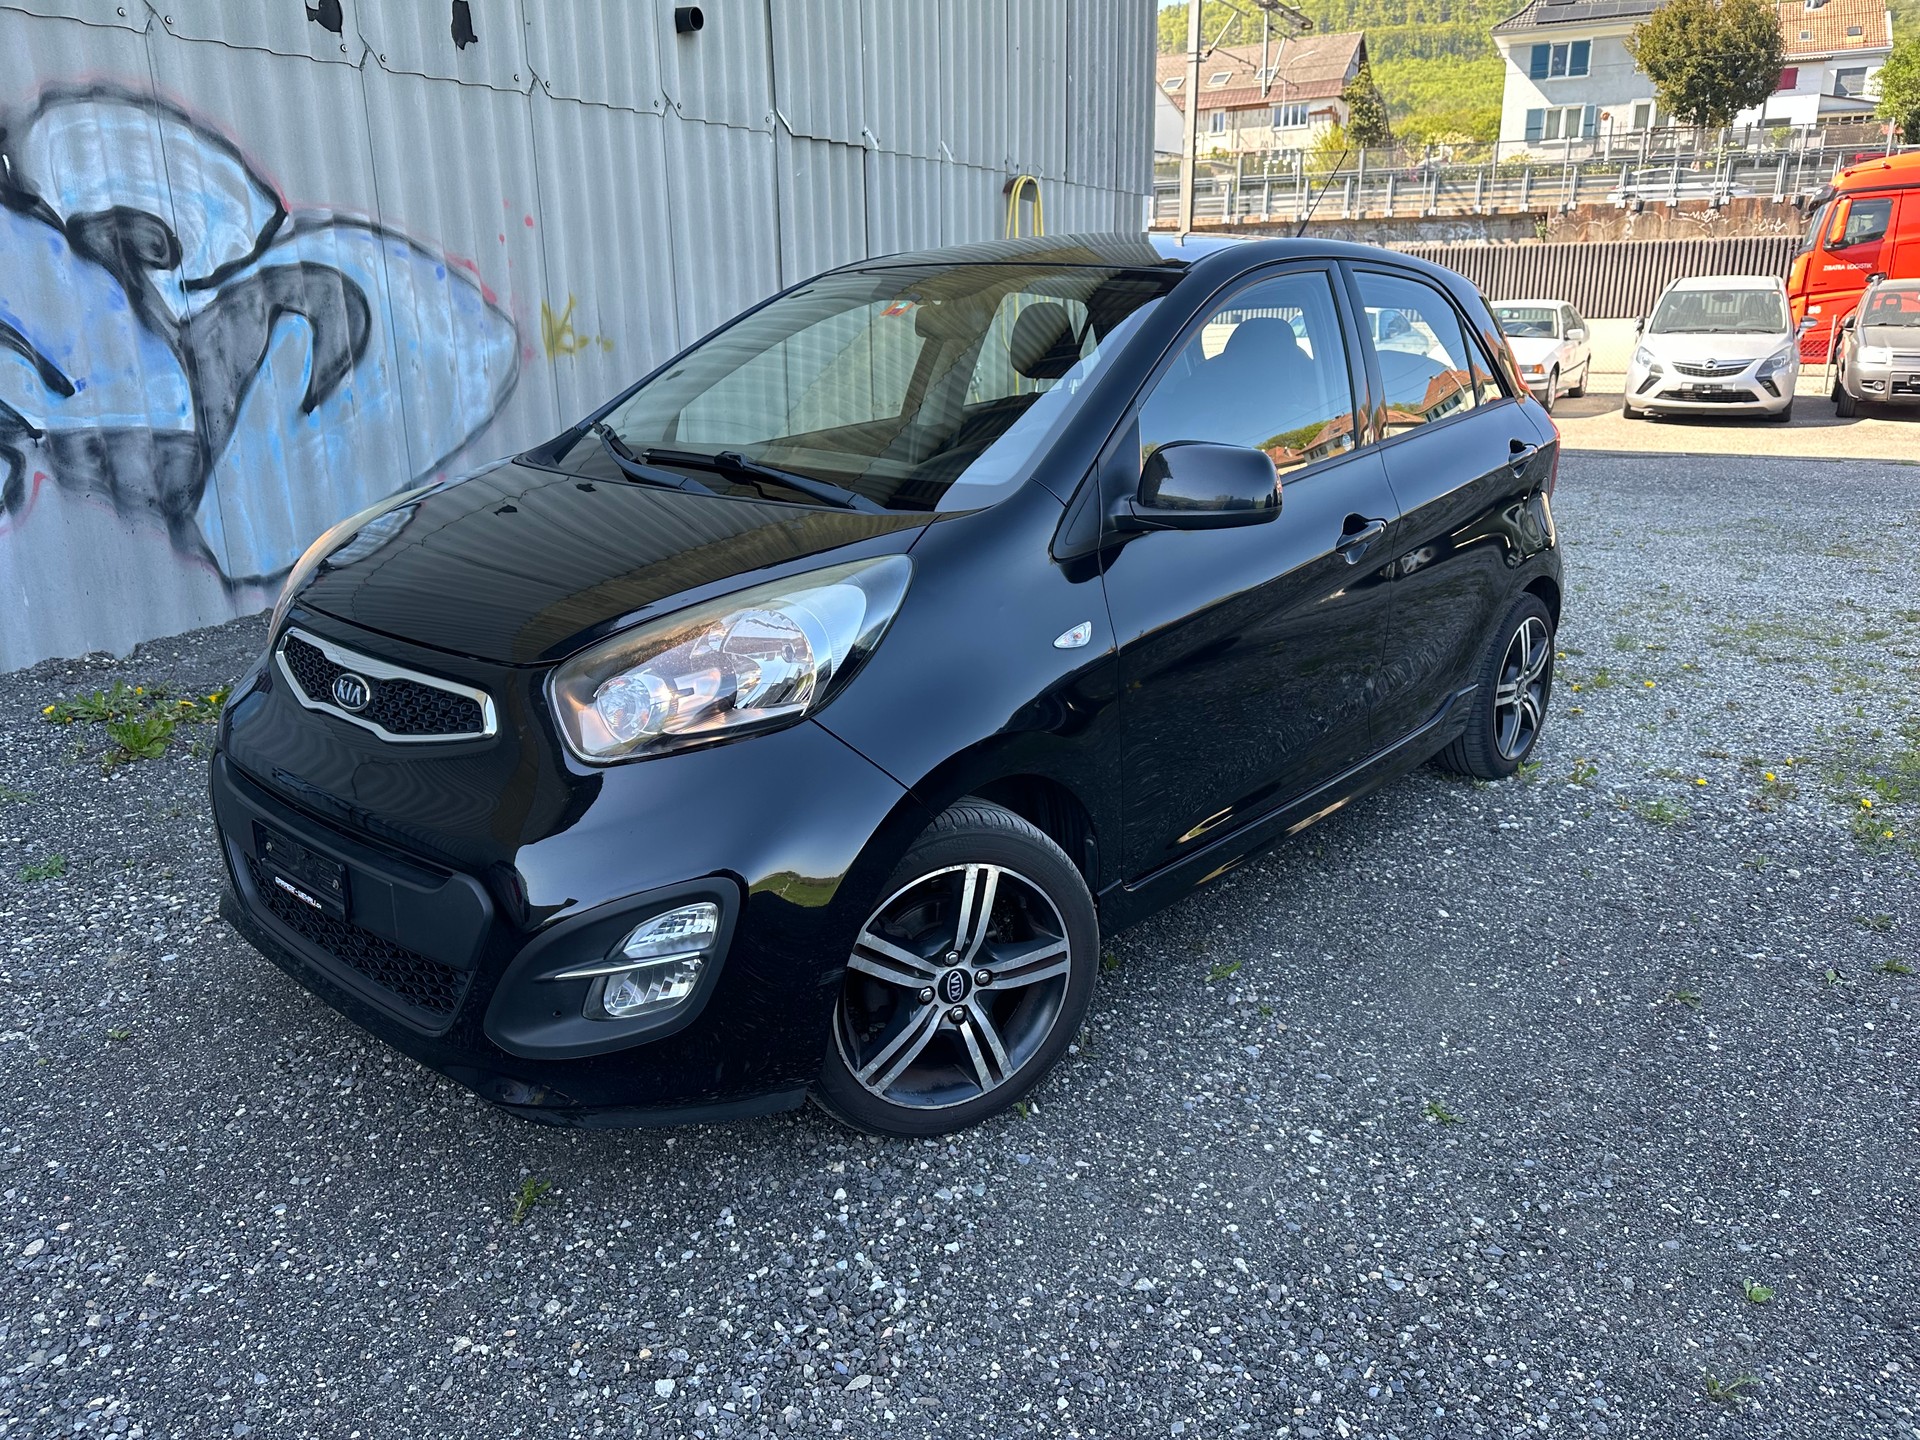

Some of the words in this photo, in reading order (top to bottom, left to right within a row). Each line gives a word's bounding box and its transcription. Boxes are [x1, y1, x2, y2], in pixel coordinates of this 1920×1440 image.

[1847, 262, 1873, 270] LOGISTIK
[336, 678, 361, 706] KIA
[950, 974, 961, 998] KIA
